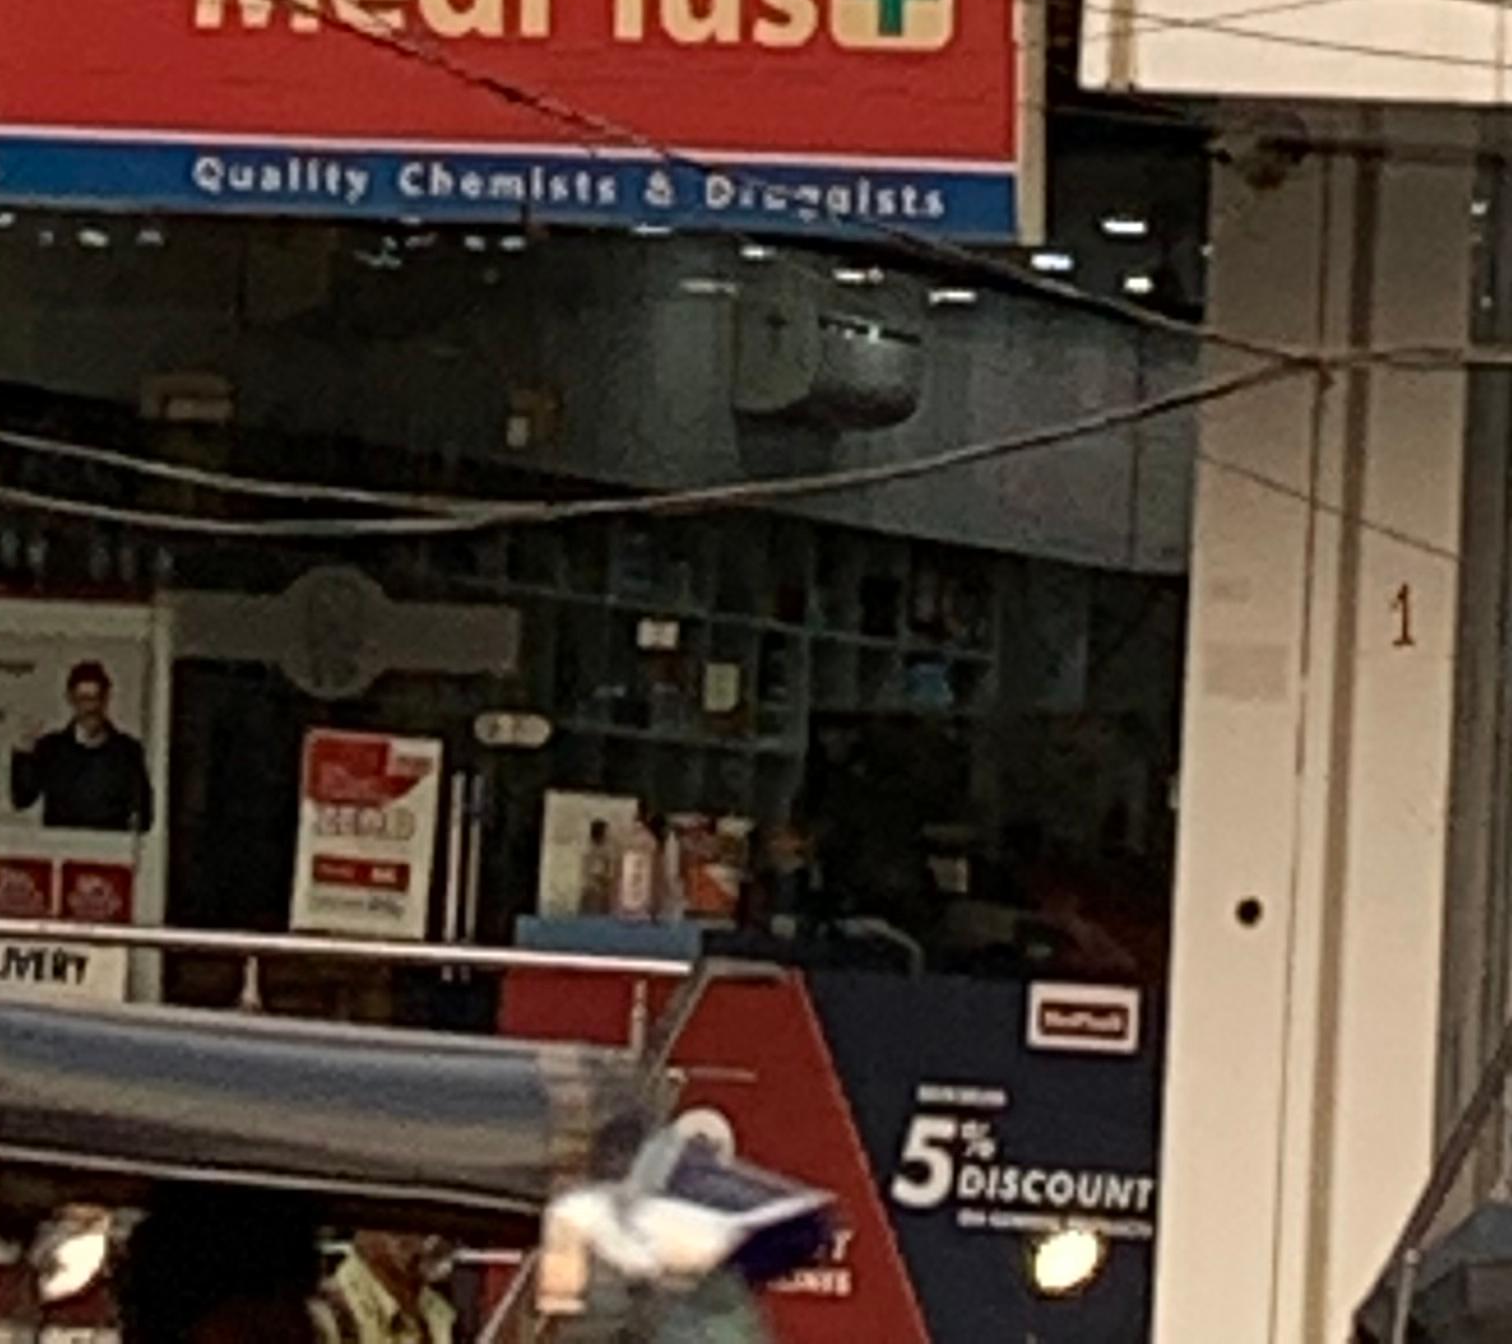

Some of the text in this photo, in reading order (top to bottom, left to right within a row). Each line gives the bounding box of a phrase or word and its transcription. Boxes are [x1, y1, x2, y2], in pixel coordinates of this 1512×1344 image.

[192, 156, 369, 203] Quality
[397, 162, 617, 206] Chemists
[645, 169, 673, 207] &
[1391, 580, 1417, 648] 1
[955, 1164, 1156, 1212] DISCOUNT
